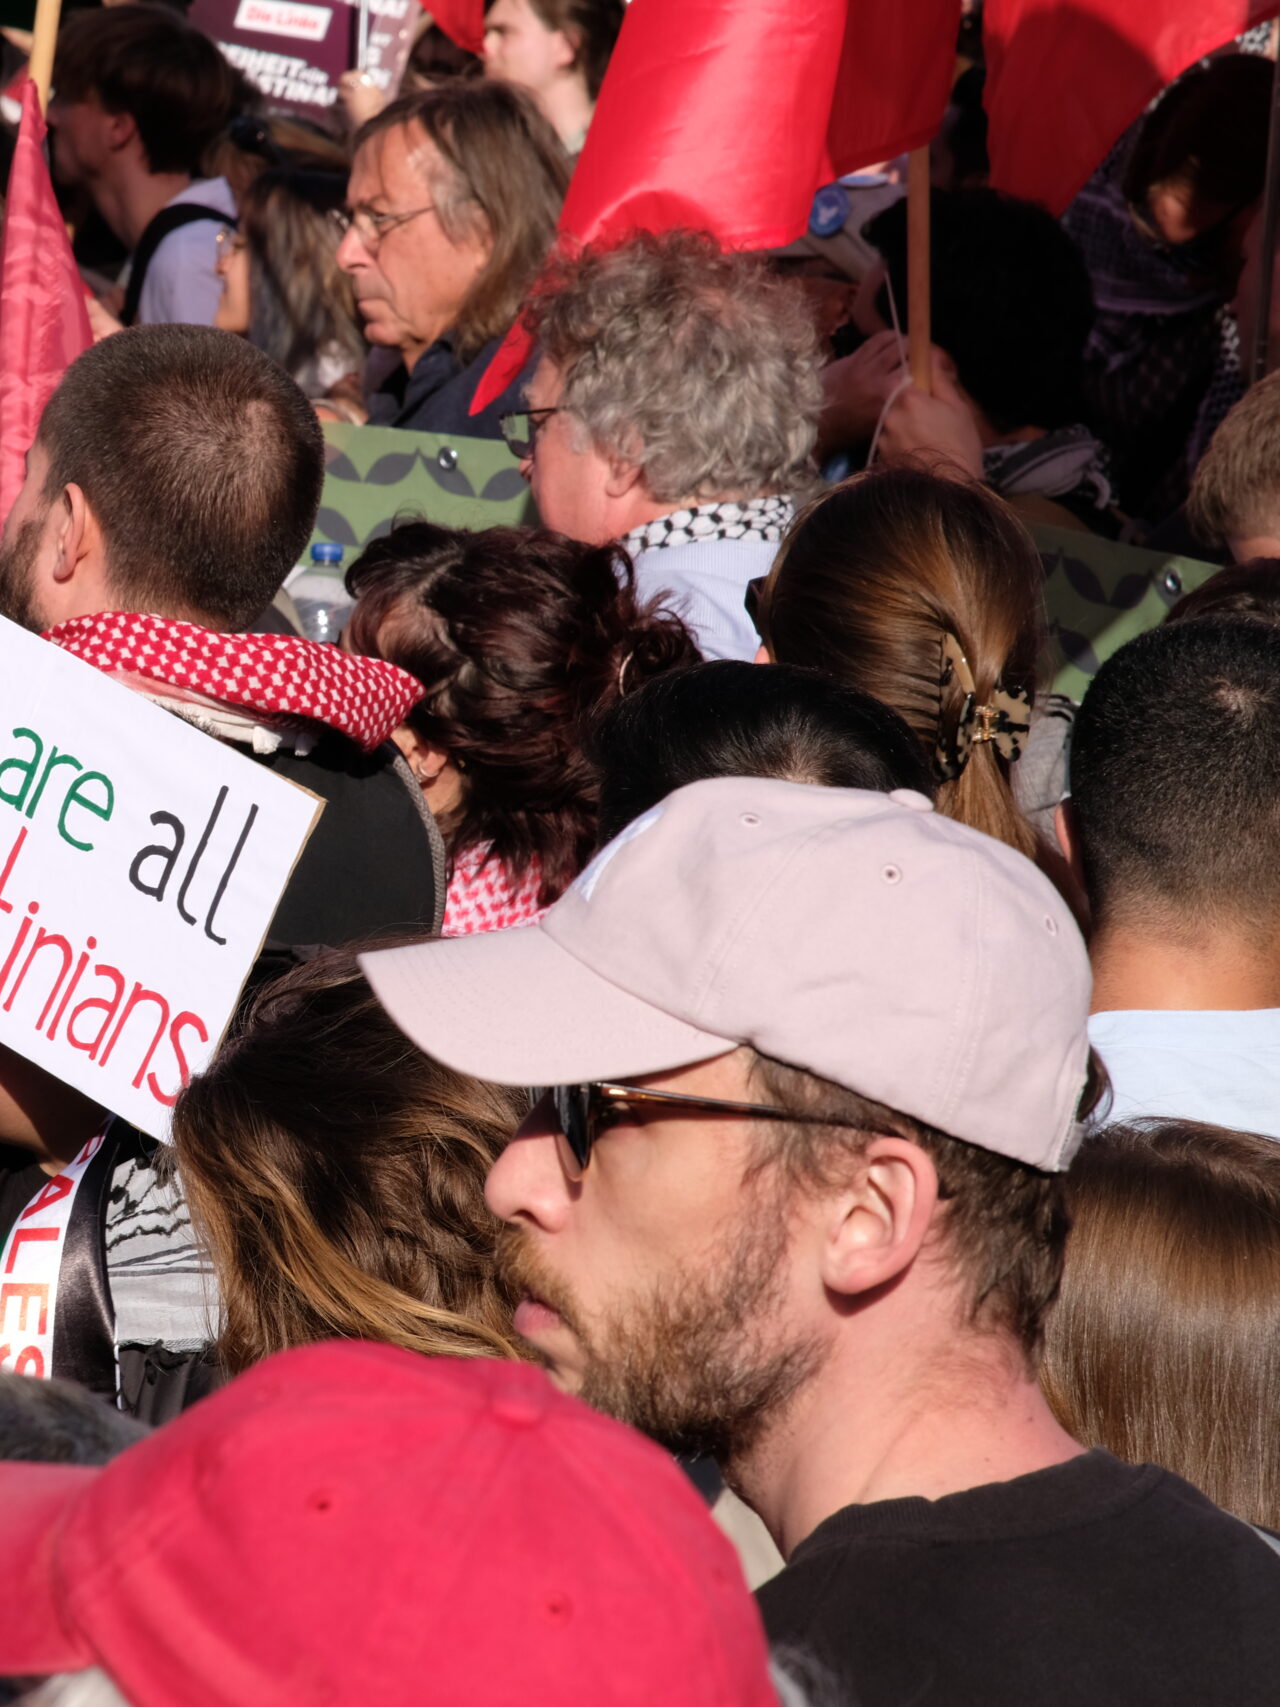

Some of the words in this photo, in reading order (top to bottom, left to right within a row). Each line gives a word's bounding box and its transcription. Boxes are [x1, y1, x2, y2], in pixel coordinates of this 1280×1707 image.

[245, 3, 272, 22] Die
[275, 7, 320, 31] Linke
[128, 784, 259, 946] all
